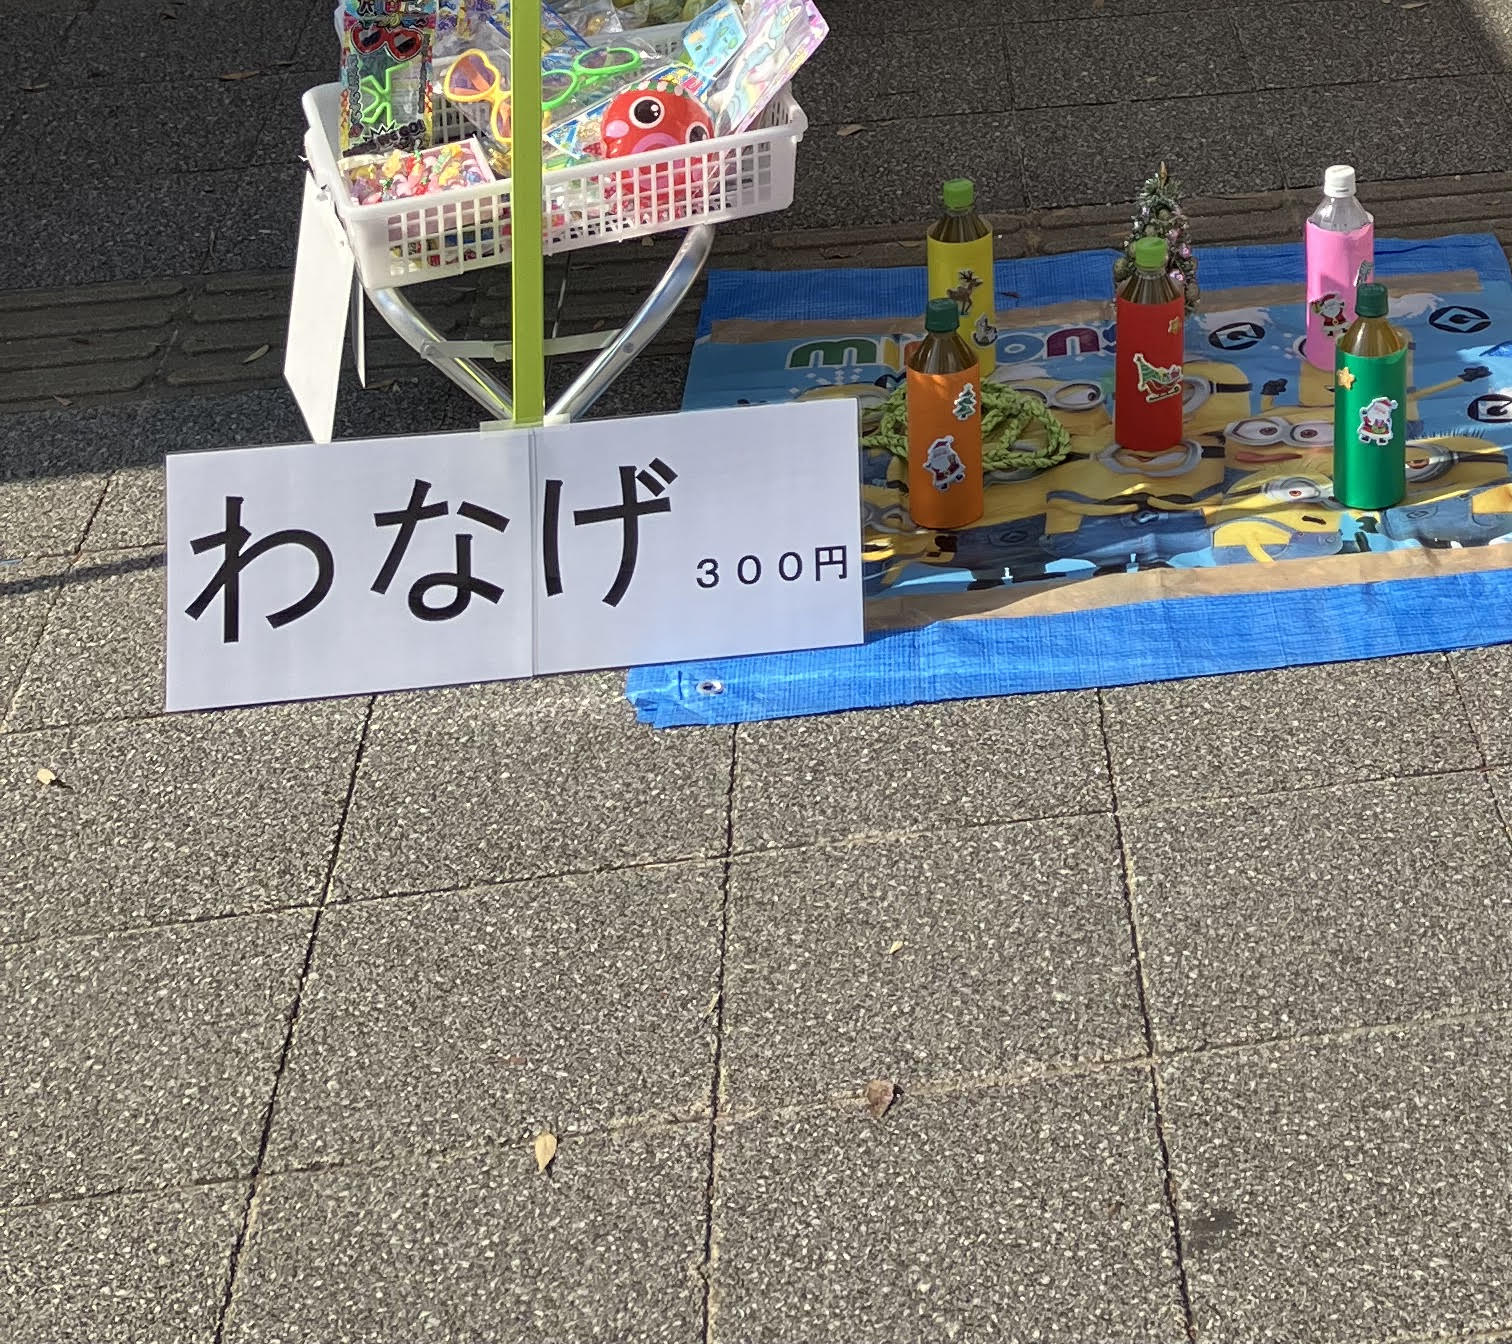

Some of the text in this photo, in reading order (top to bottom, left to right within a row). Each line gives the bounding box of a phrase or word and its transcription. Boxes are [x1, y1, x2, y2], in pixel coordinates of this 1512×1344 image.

[185, 458, 677, 643] わなげ
[696, 544, 848, 589] 300円
